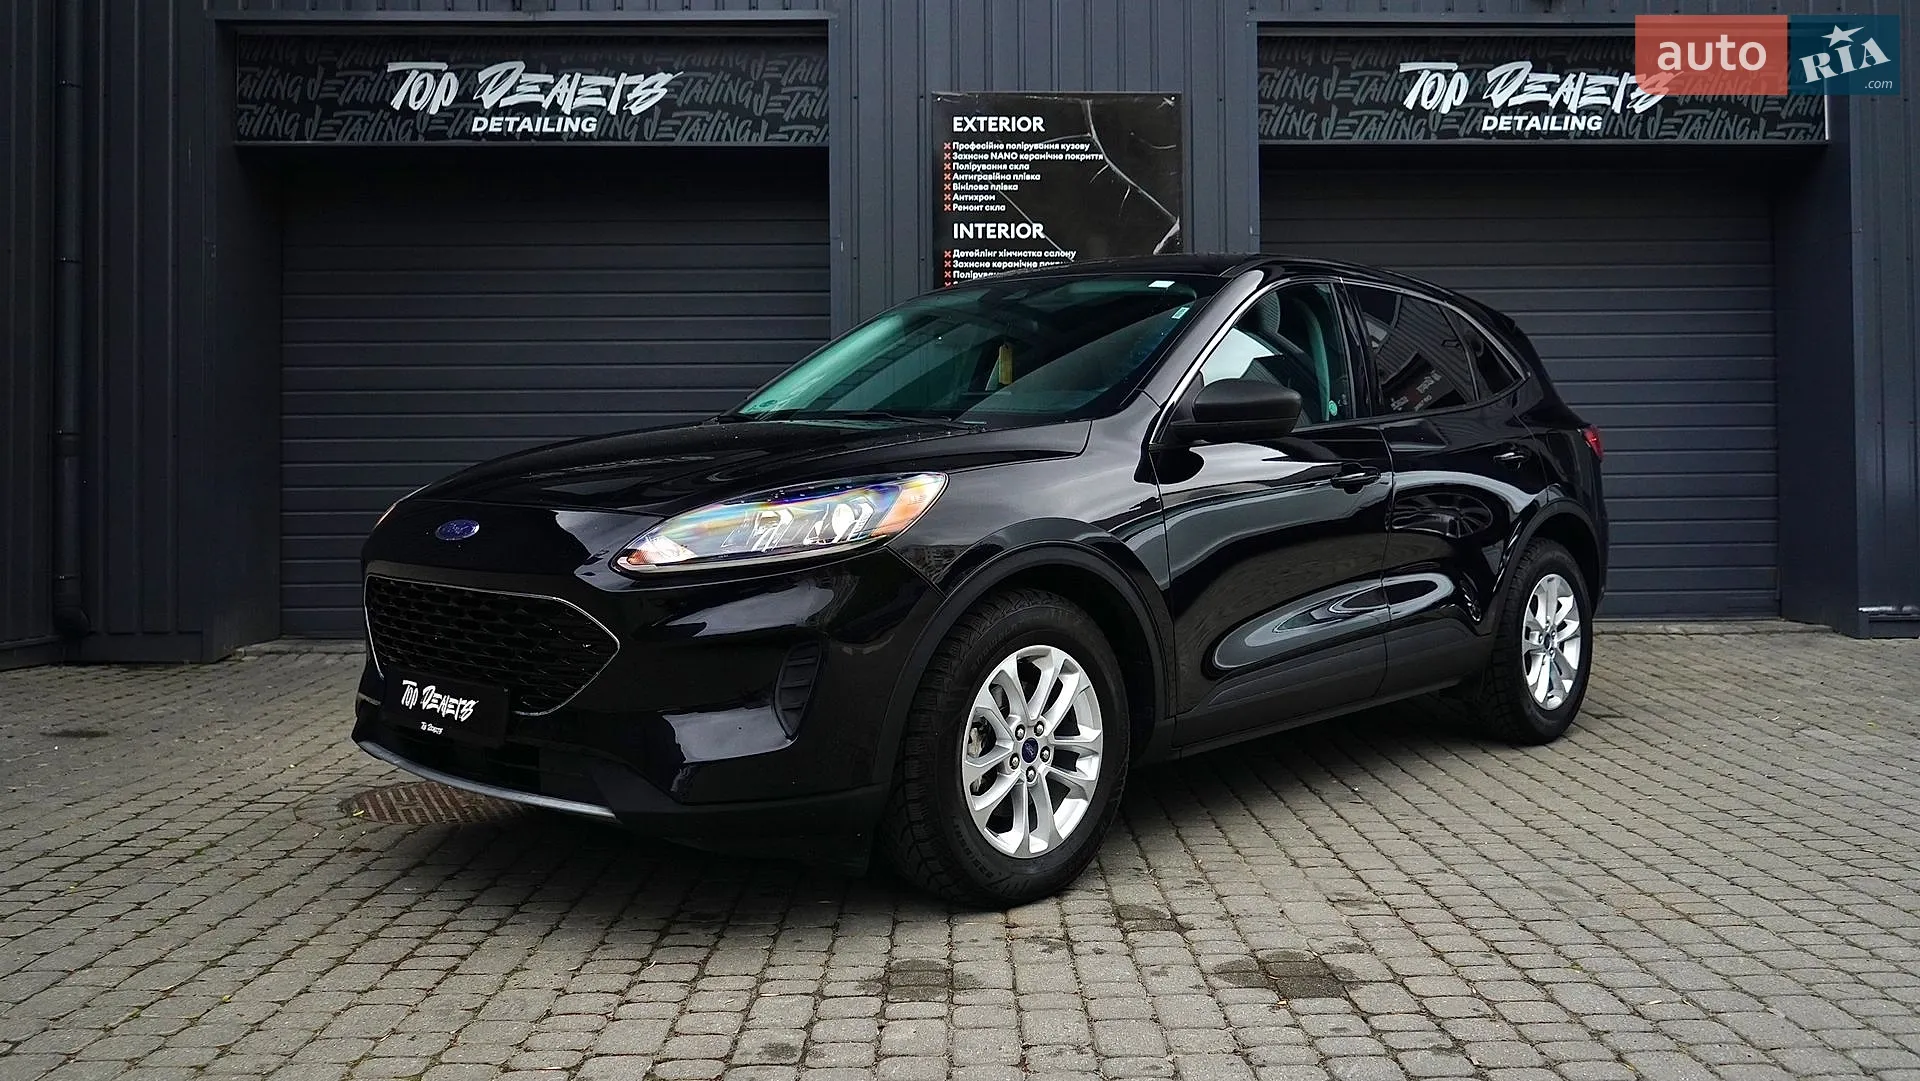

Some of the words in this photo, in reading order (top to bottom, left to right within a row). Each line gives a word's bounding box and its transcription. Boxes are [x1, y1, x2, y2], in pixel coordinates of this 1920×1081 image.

[472, 116, 598, 133] DETAILING
[952, 116, 1045, 132] EXTERIOR
[1481, 115, 1603, 131] DETAILING
[1006, 141, 1059, 151] полірування
[1061, 143, 1090, 151] кузову
[990, 152, 1018, 161] NANO
[1065, 153, 1104, 162] покриття
[952, 162, 1007, 172] Полірування
[1009, 163, 1029, 171] скла
[1013, 172, 1040, 181] плівка
[952, 182, 988, 191] Вінілова
[990, 182, 1018, 191] плівка
[952, 193, 995, 202] Антихром
[952, 203, 983, 212] Ремонт
[984, 203, 1005, 212] скла
[953, 223, 1046, 239] INTERIOR
[998, 248, 1042, 258] хімчистка
[1044, 250, 1076, 259] салону
